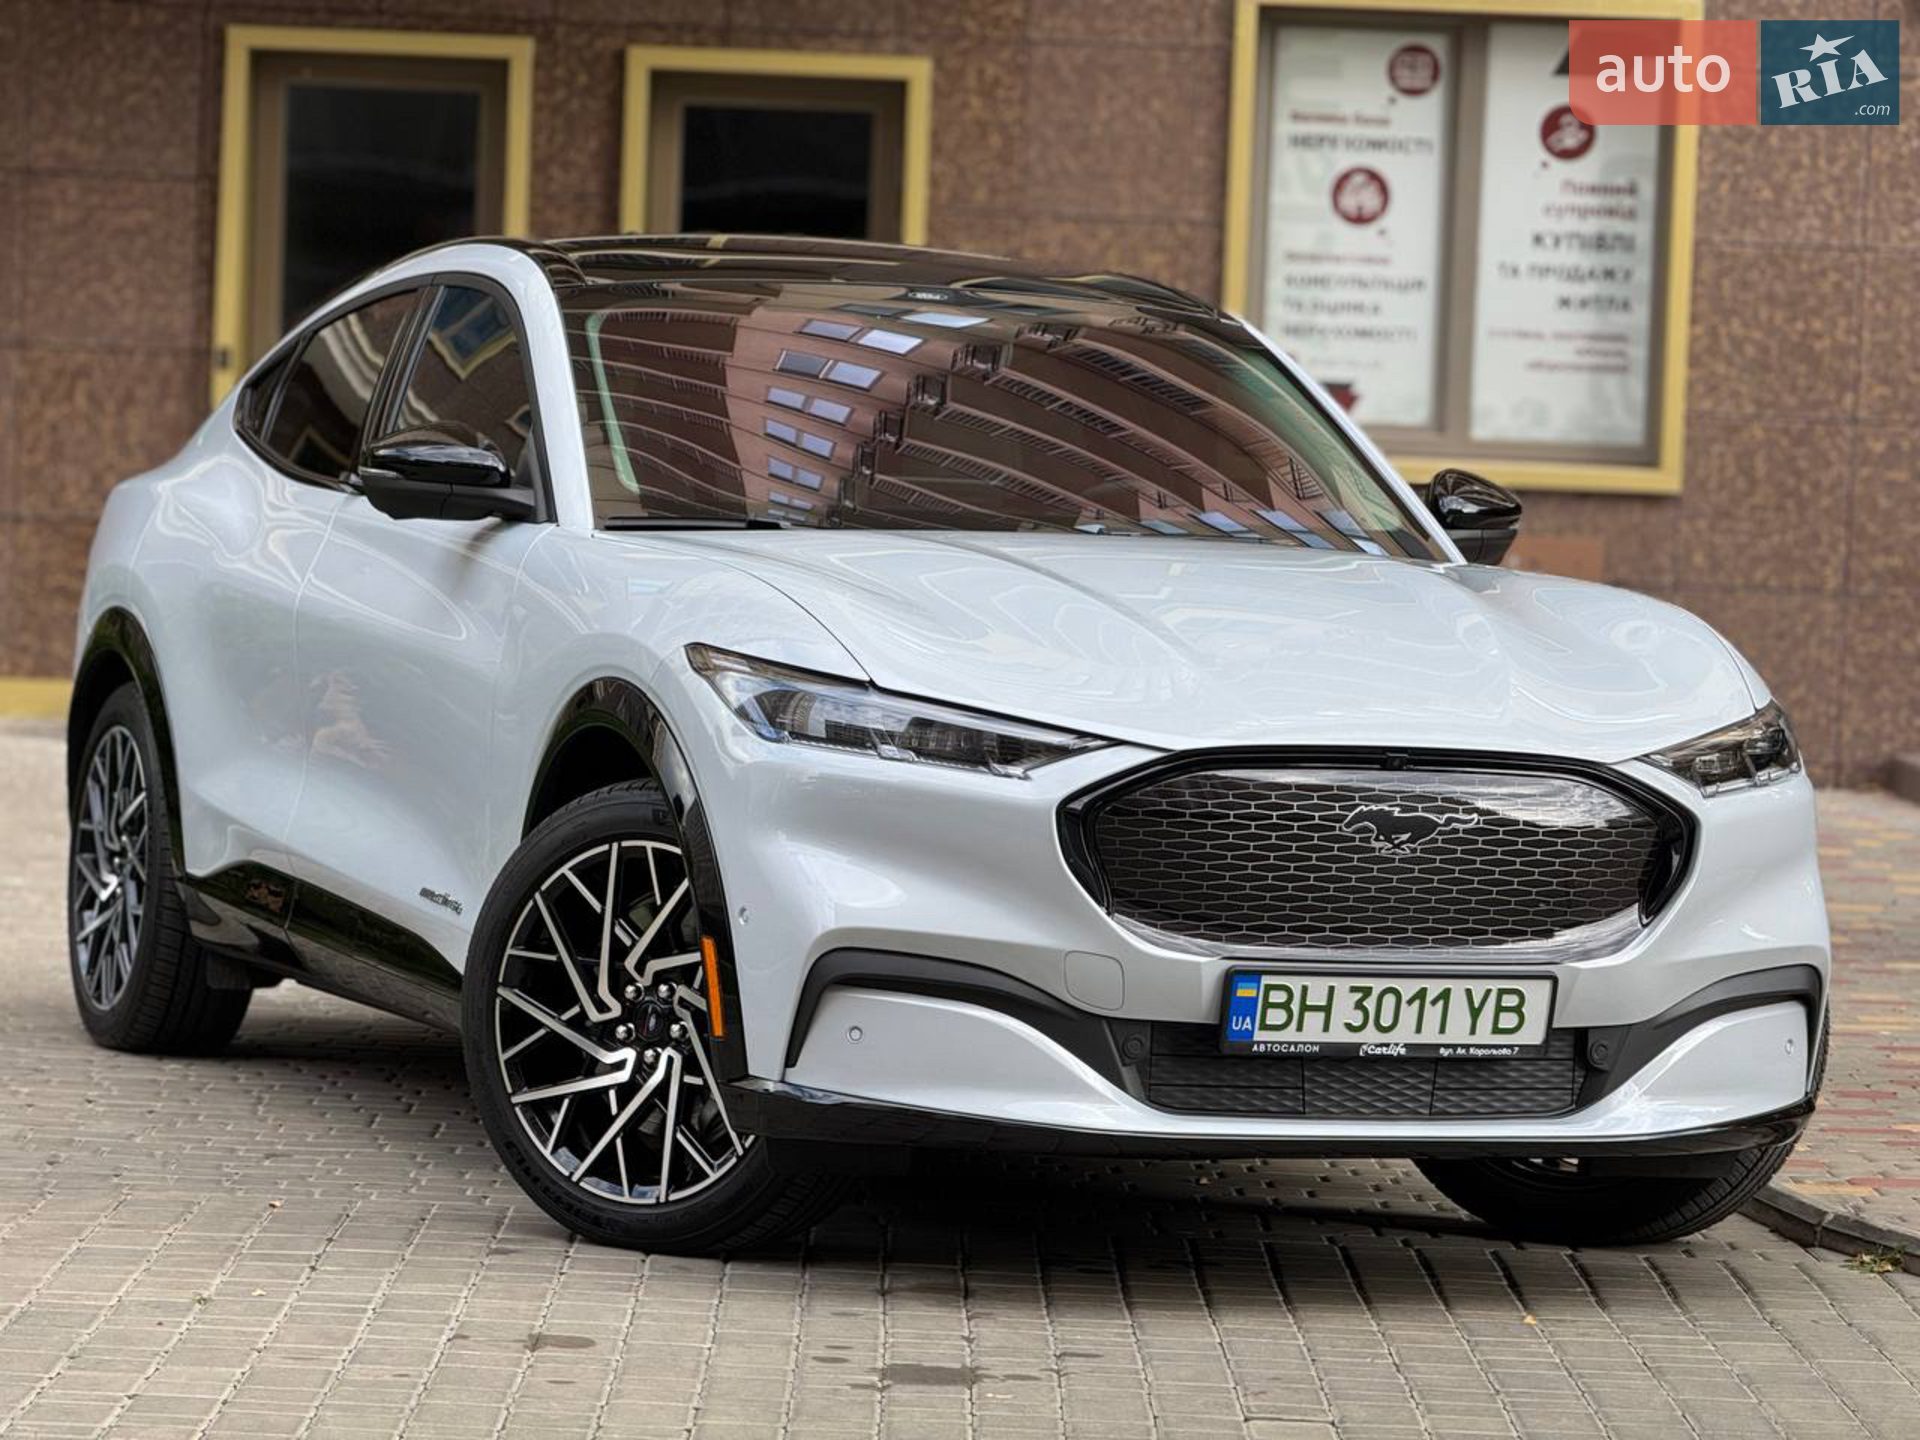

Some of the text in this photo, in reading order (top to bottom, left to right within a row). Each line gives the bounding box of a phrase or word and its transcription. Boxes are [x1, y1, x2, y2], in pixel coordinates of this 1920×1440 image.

[1258, 984, 1527, 1036] BH 3011 YB
[1232, 1016, 1252, 1032] UA
[1251, 1043, 1320, 1054] АВТОСАЛОН
